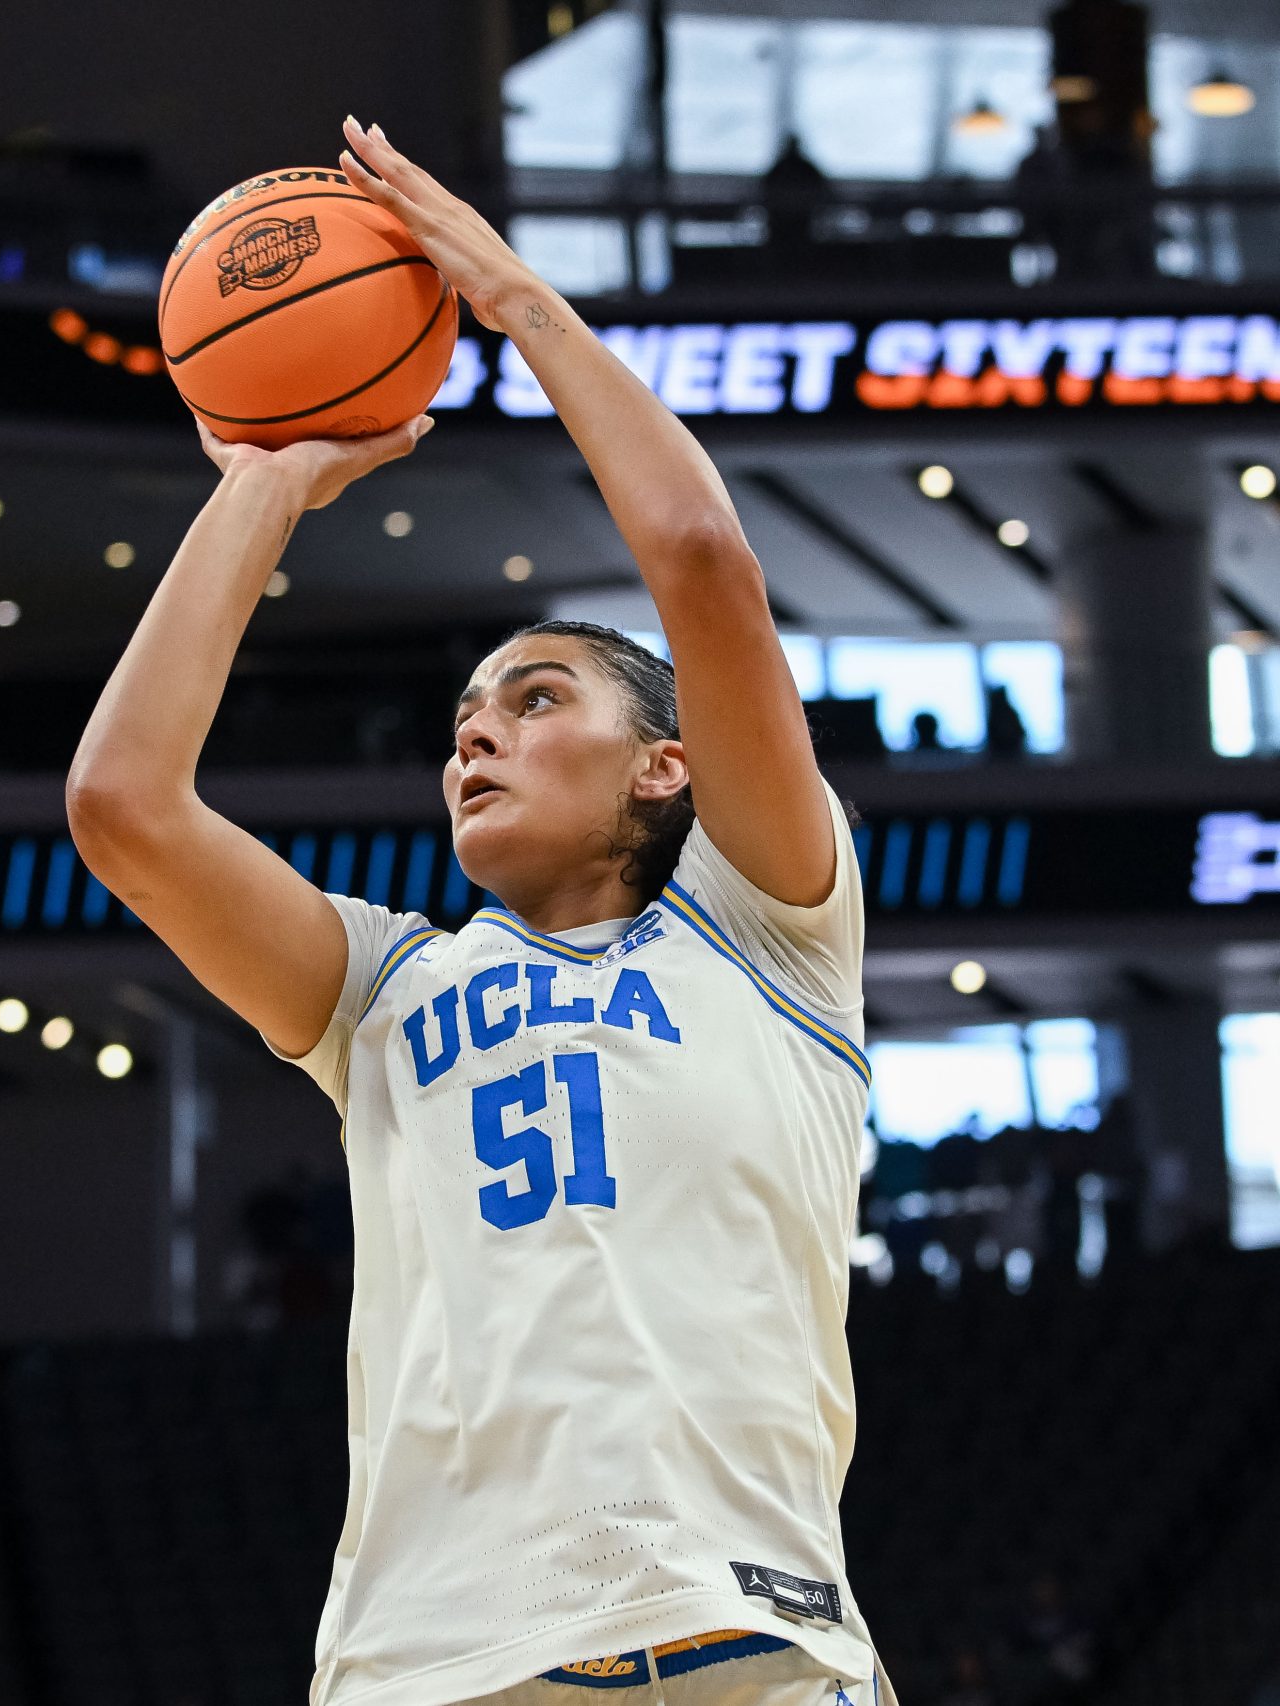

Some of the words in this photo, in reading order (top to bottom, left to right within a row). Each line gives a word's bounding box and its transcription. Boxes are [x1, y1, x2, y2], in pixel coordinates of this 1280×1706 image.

[233, 227, 288, 263] MARCH
[244, 233, 320, 275] MADNESS
[627, 913, 659, 939] NCAA
[402, 961, 682, 1088] UCLA
[471, 1051, 617, 1232] 51
[805, 1590, 825, 1605] 50
[561, 1654, 638, 1678] ucla
